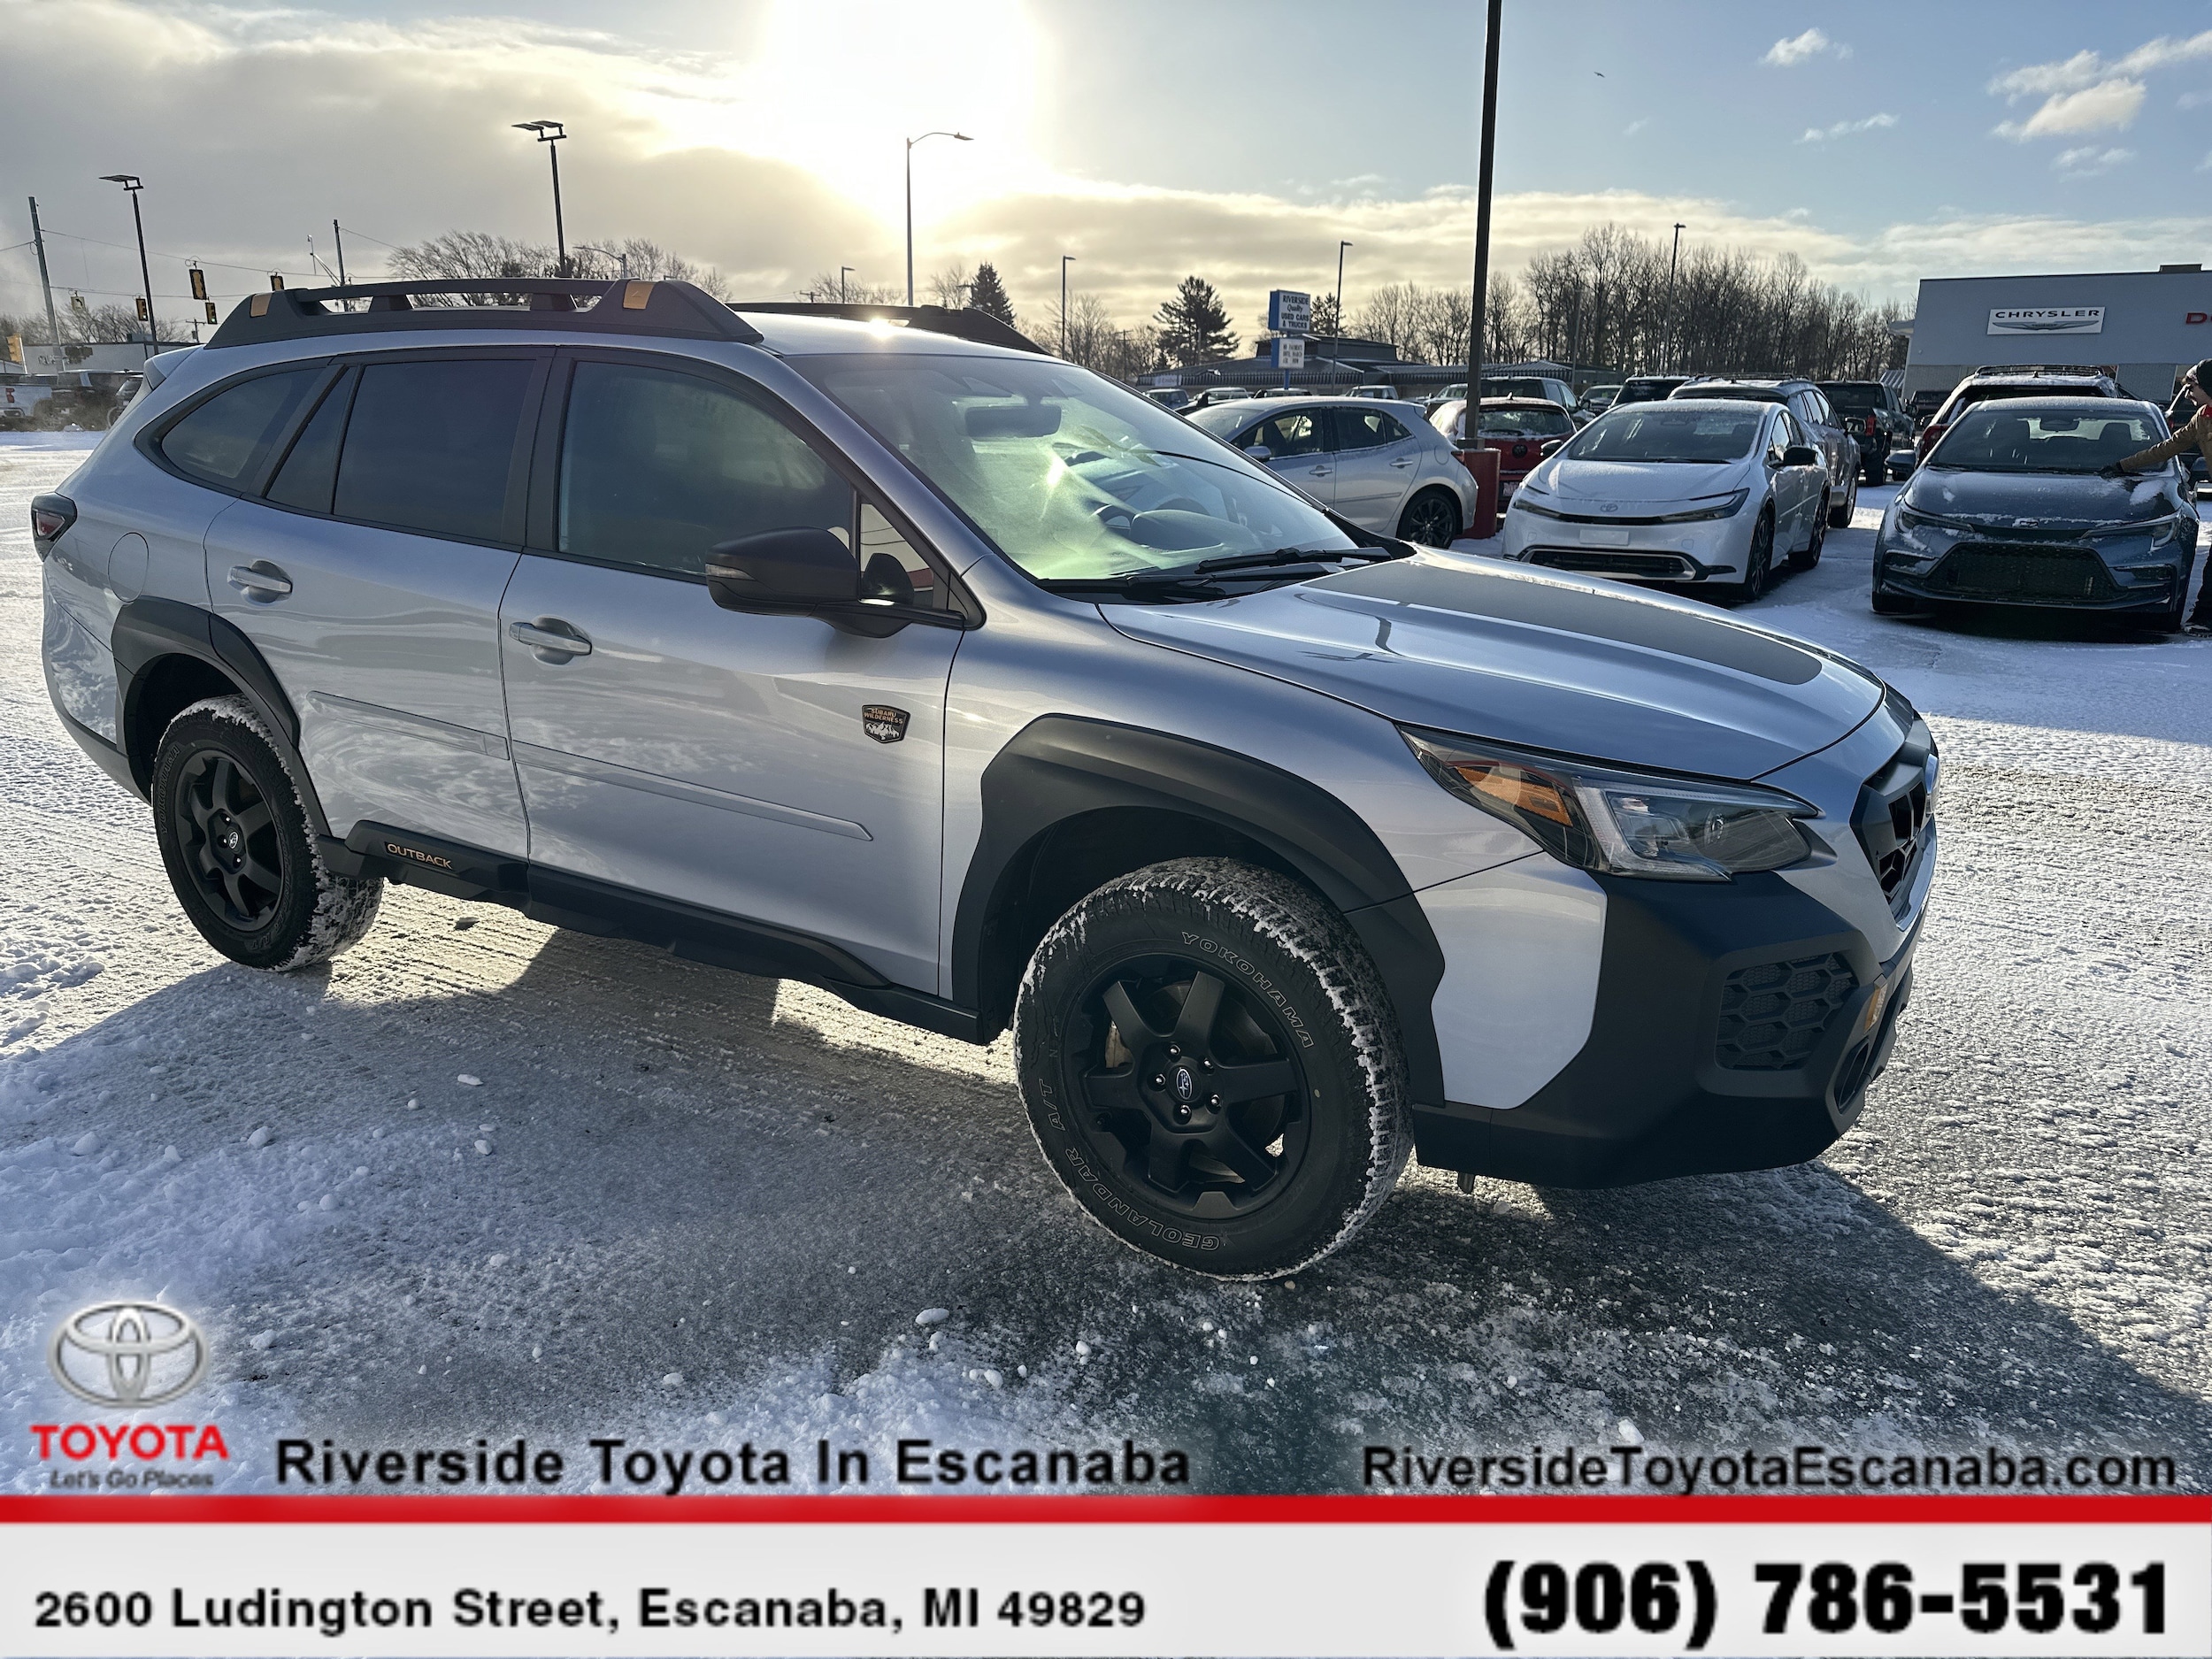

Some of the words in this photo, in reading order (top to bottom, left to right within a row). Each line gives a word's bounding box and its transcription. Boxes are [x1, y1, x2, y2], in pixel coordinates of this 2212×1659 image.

[1283, 295, 1309, 305] RIVERSIDE
[1995, 310, 2100, 319] CHRYSLER
[864, 711, 903, 725] WILDERNESS
[871, 708, 897, 718] SUBARU
[157, 744, 180, 835] YOKOHAMA
[387, 843, 453, 870] OUTBACK
[1181, 931, 1316, 1048] YOKOHAMA
[1039, 1078, 1066, 1132] A/T
[1064, 1147, 1220, 1251] GEOLANDAR
